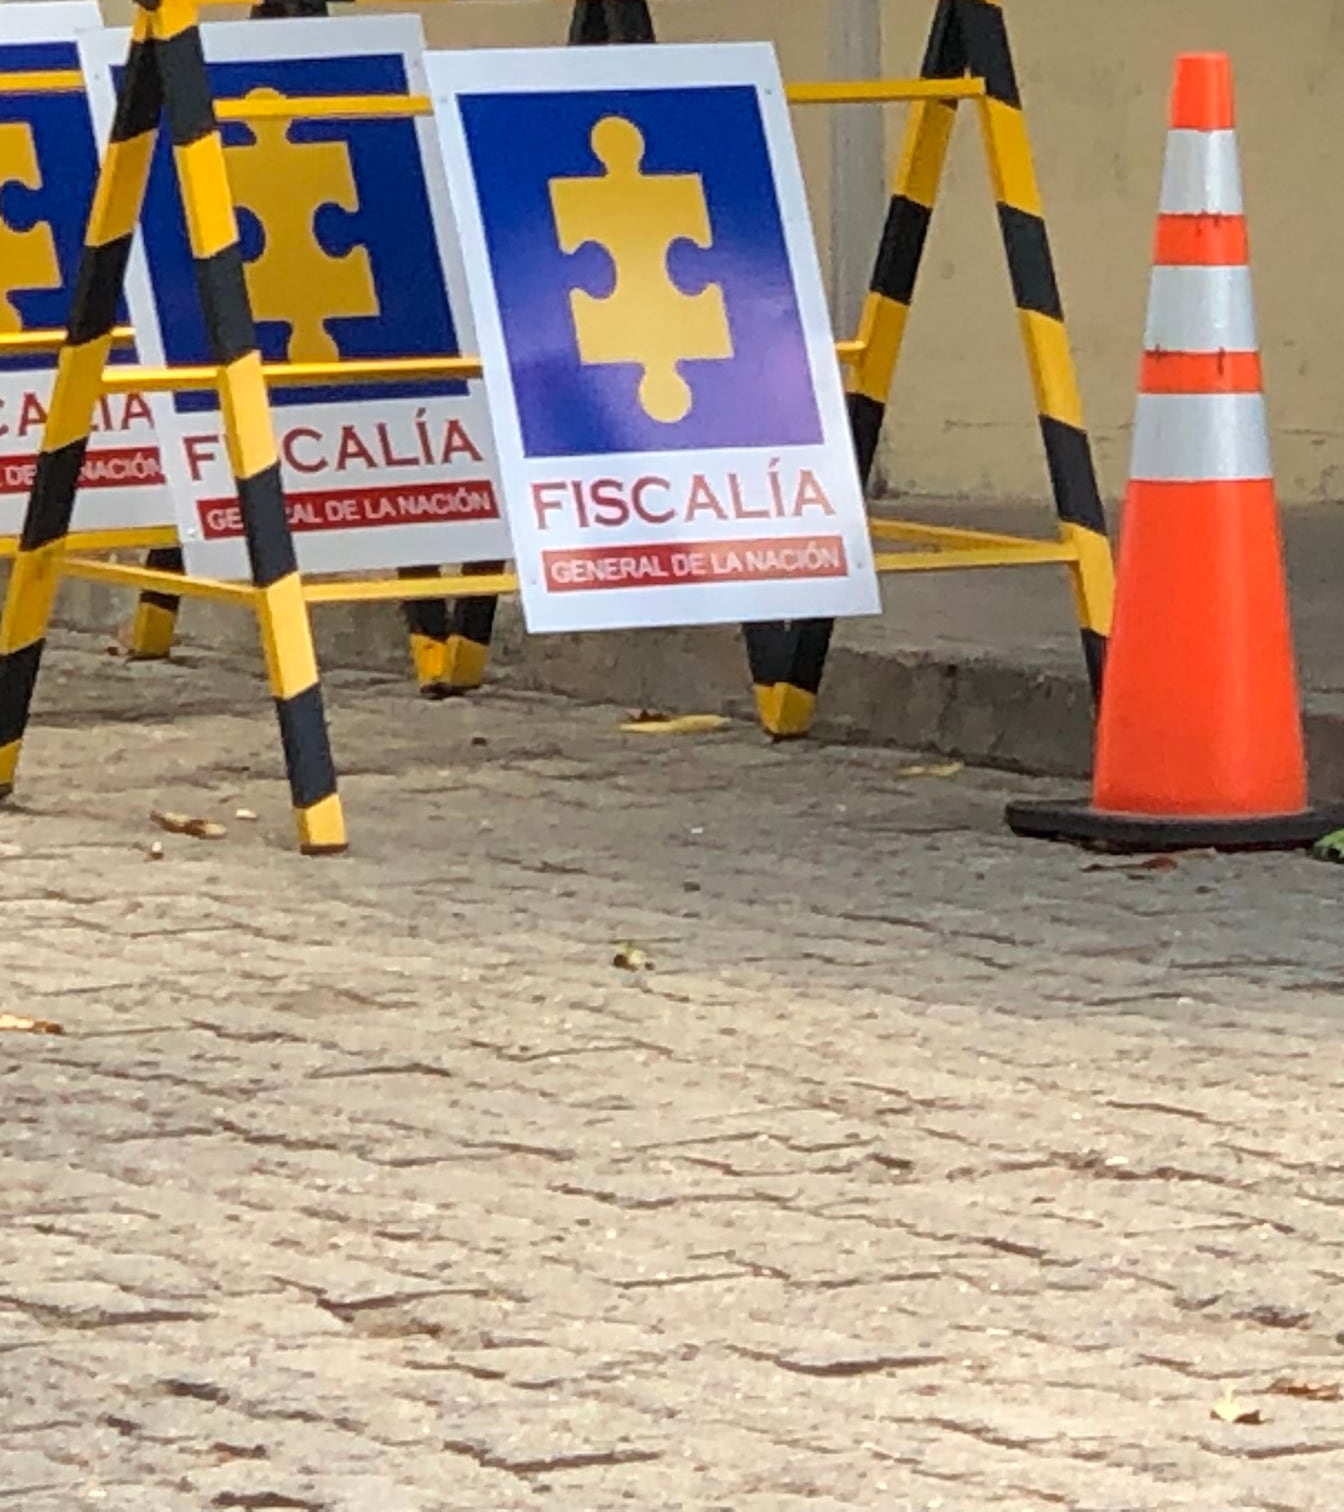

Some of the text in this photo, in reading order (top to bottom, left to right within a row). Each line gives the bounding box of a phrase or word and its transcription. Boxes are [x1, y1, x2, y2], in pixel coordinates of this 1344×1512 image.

[183, 407, 483, 481] FCALÍA
[207, 487, 491, 530] GEAL DE LA NACIÓN
[530, 457, 836, 530] FISCALÍA
[551, 540, 841, 584] GENERAL DE LA NACIÓN
